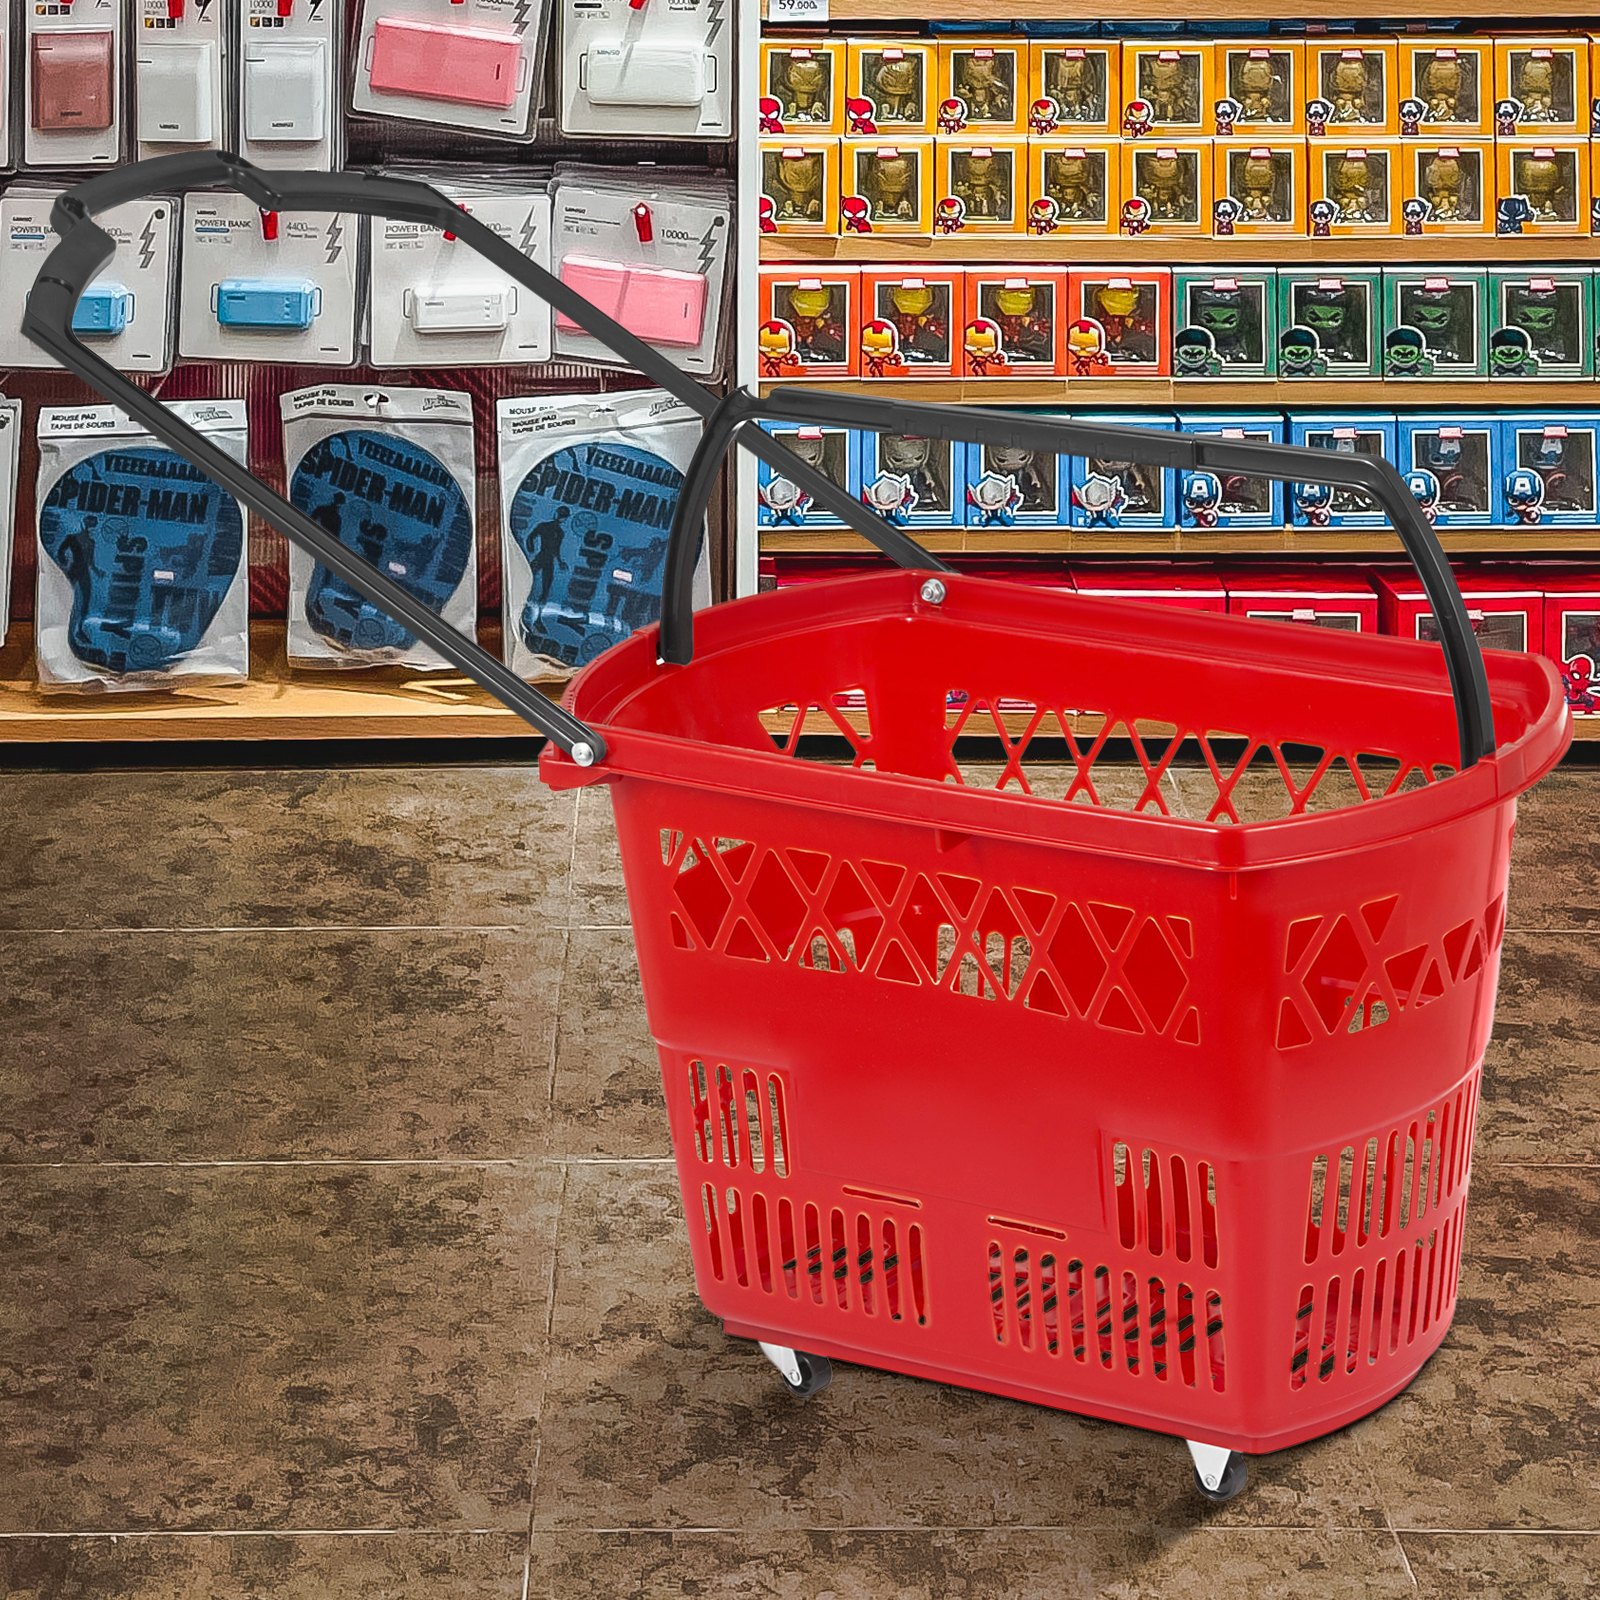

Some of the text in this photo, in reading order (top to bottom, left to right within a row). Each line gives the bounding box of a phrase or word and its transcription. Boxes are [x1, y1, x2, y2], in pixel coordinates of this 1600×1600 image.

[195, 219, 252, 228] POWER BANK
[385, 224, 442, 233] POWER BAN
[11, 225, 41, 233] POWER
[294, 392, 320, 402] MOUSE
[294, 400, 315, 410] TAPIS
[52, 413, 97, 422] MOUSE PAD
[512, 414, 557, 428] MOUSE PAD
[51, 422, 73, 430] TAPIS
[512, 425, 534, 434] TAPIS
[535, 424, 546, 432] DE
[300, 450, 447, 529] SPIDER-MAN
[45, 478, 209, 524] SPIDER-MAN
[521, 466, 678, 530] SPIDER-MAN
